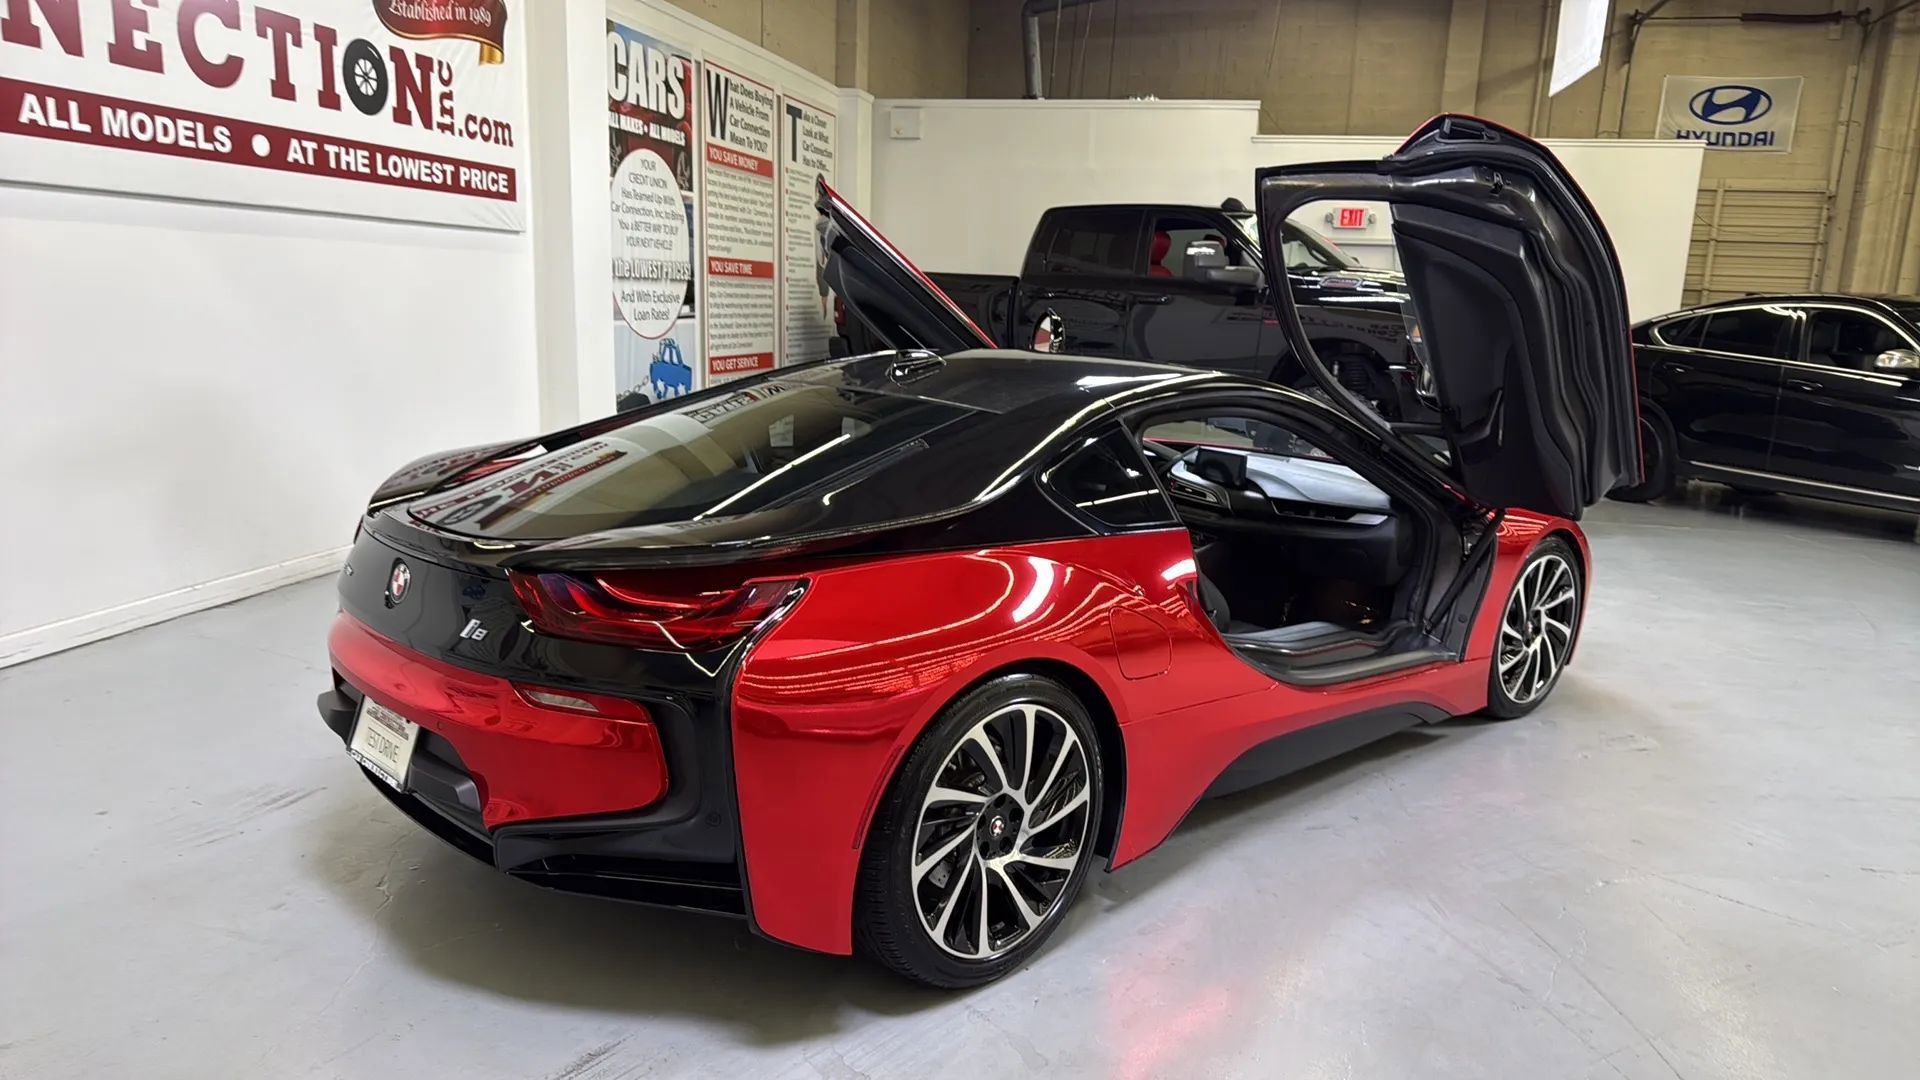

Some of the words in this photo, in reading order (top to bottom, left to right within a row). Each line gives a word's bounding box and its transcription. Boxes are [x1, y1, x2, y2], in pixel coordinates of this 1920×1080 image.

[455, 3, 467, 20] in
[469, 7, 492, 27] 1989
[607, 31, 686, 119] CARS
[740, 83, 754, 100] Does
[17, 92, 92, 134] ALL
[100, 105, 233, 153] MODELS
[458, 114, 514, 147] .com
[729, 114, 739, 128] Car
[740, 118, 770, 138] Connection
[1676, 129, 1775, 146] HYUNDAI
[286, 138, 319, 166] AT
[323, 143, 371, 174] THE
[375, 152, 454, 186] LOWEST
[459, 166, 509, 194] PRICE
[709, 145, 722, 160] YOU
[723, 150, 739, 166] SAVE
[611, 201, 620, 212] Car
[1340, 208, 1364, 227] EXIT
[711, 259, 724, 272] YOU
[724, 261, 740, 274] SAVE
[634, 307, 650, 321] Loan
